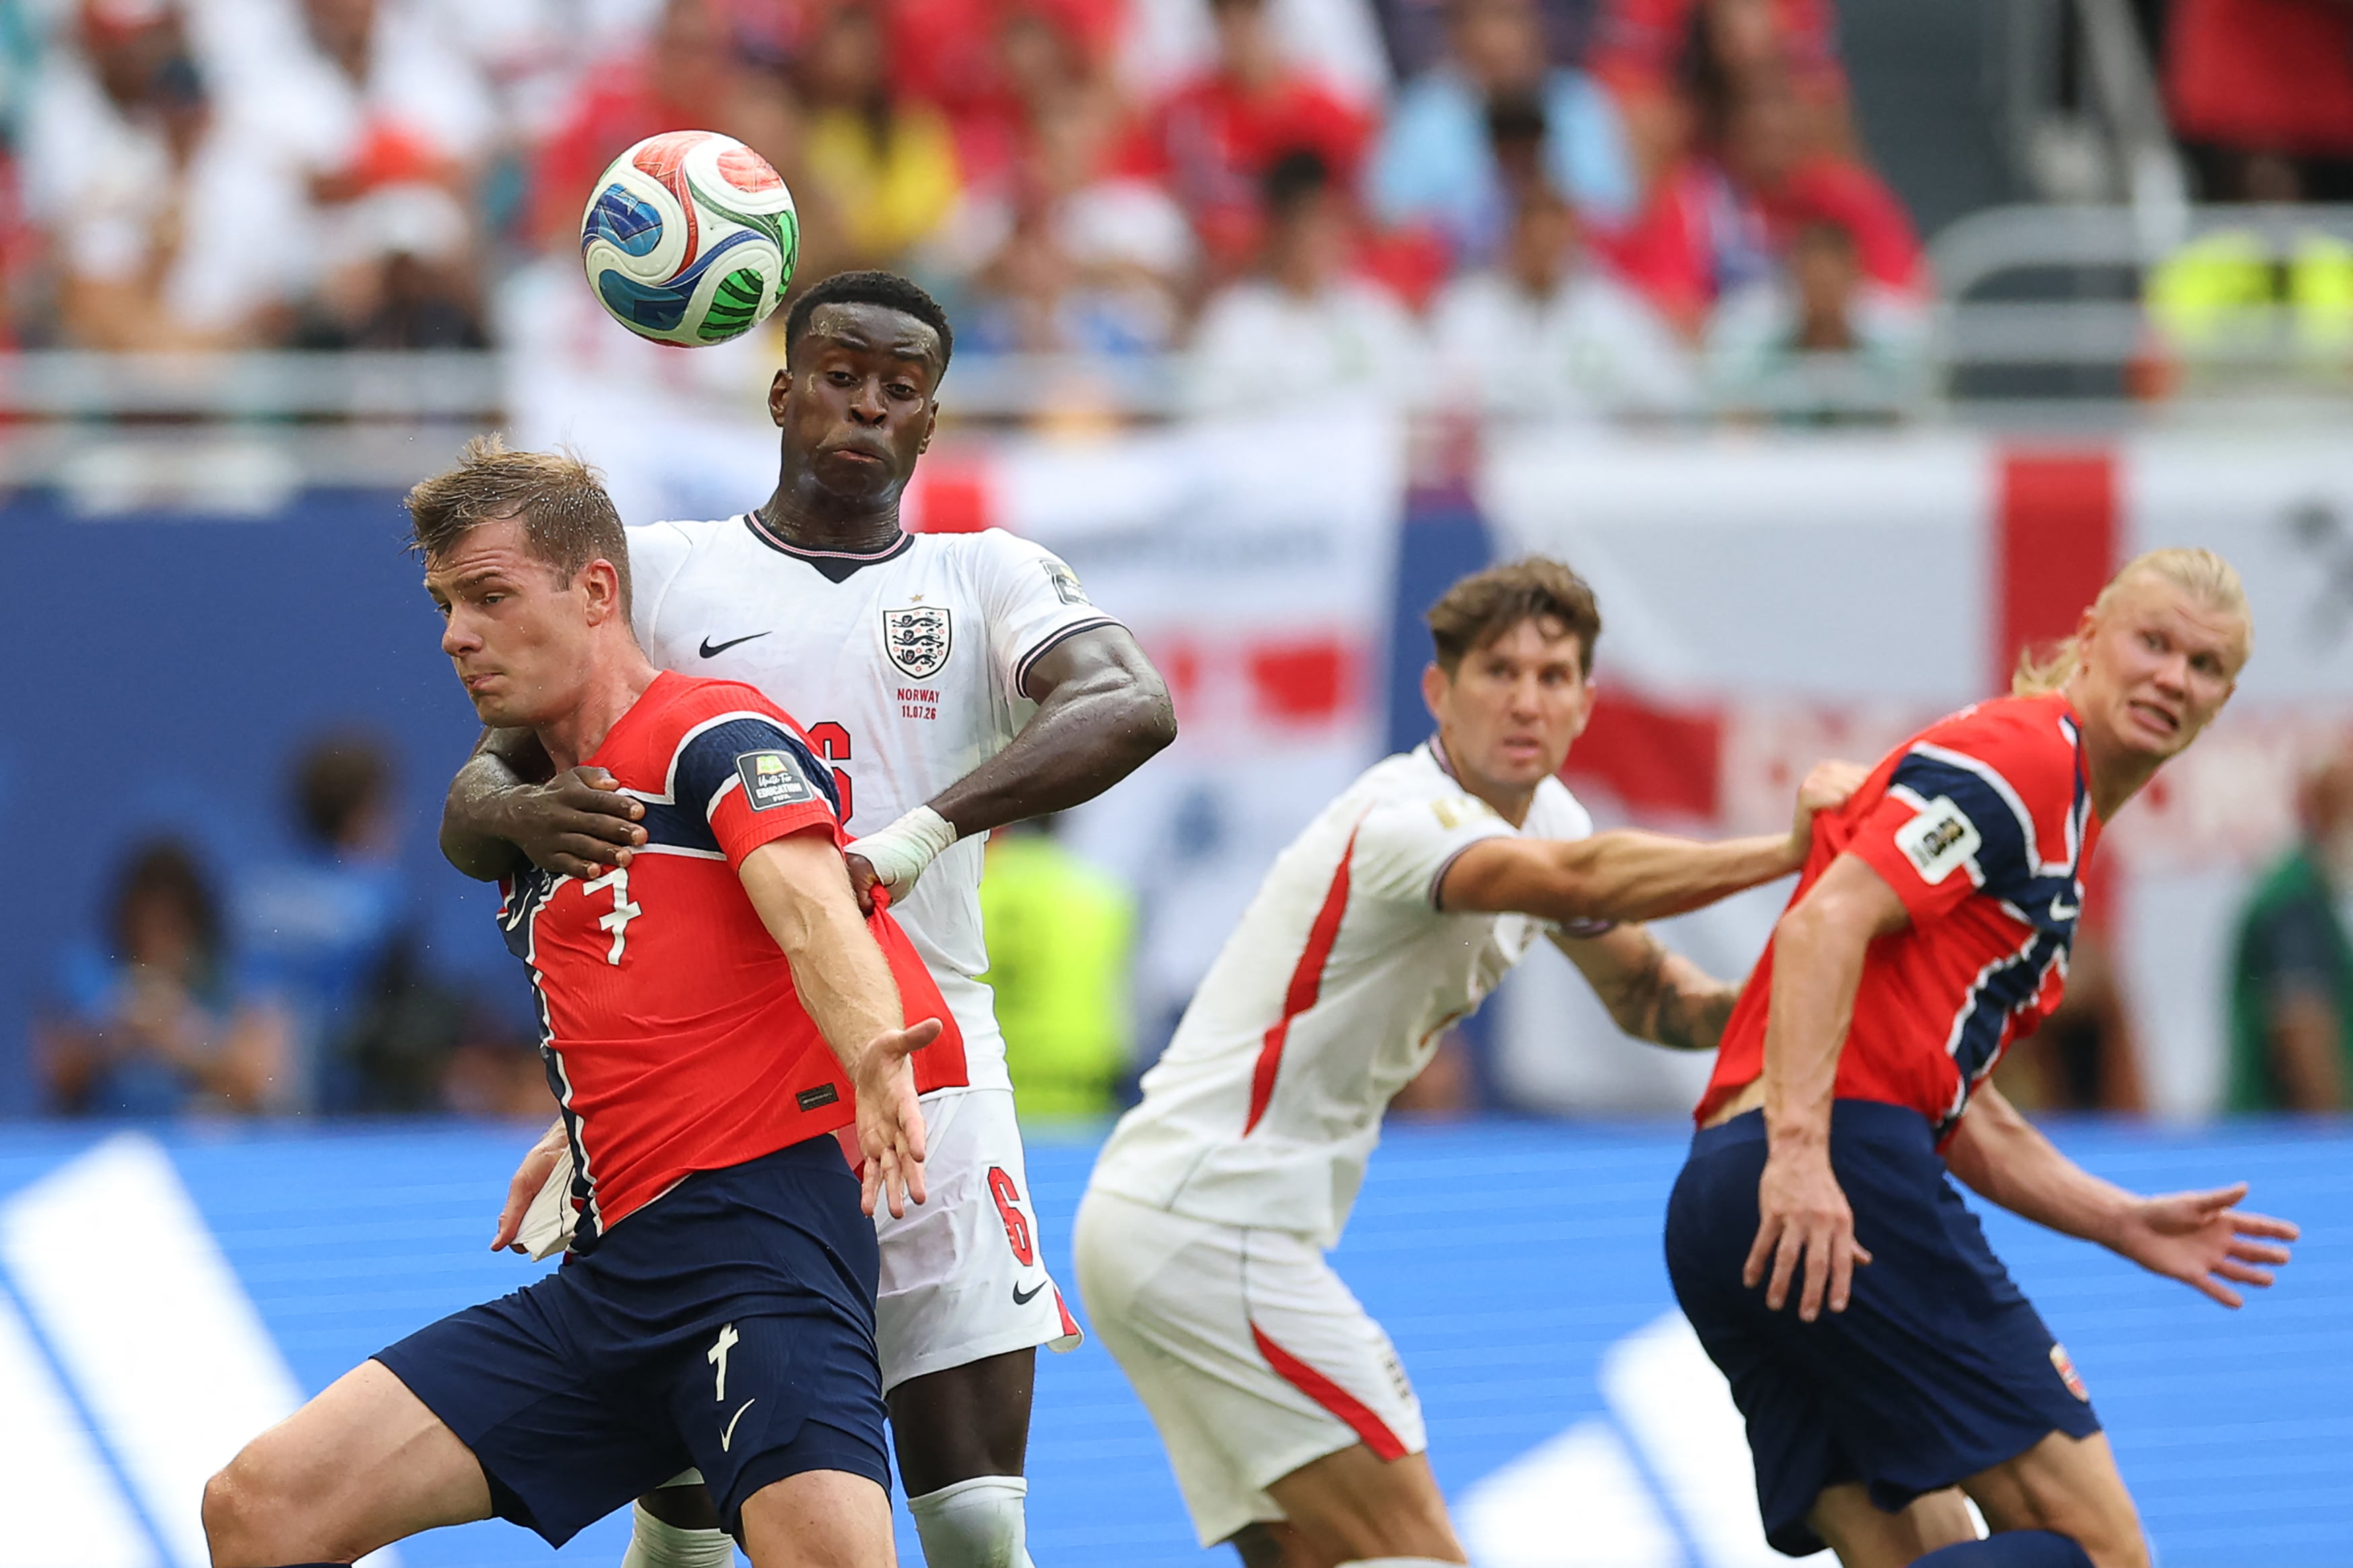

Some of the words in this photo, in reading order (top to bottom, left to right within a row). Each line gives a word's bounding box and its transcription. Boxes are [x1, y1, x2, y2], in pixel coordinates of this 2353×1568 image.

[898, 688, 940, 703] NORWAY
[902, 706, 936, 720] 11.07.26
[756, 783, 802, 798] EDUCATION
[807, 721, 853, 826] 6
[583, 867, 642, 966] 7
[988, 1166, 1033, 1266] 6
